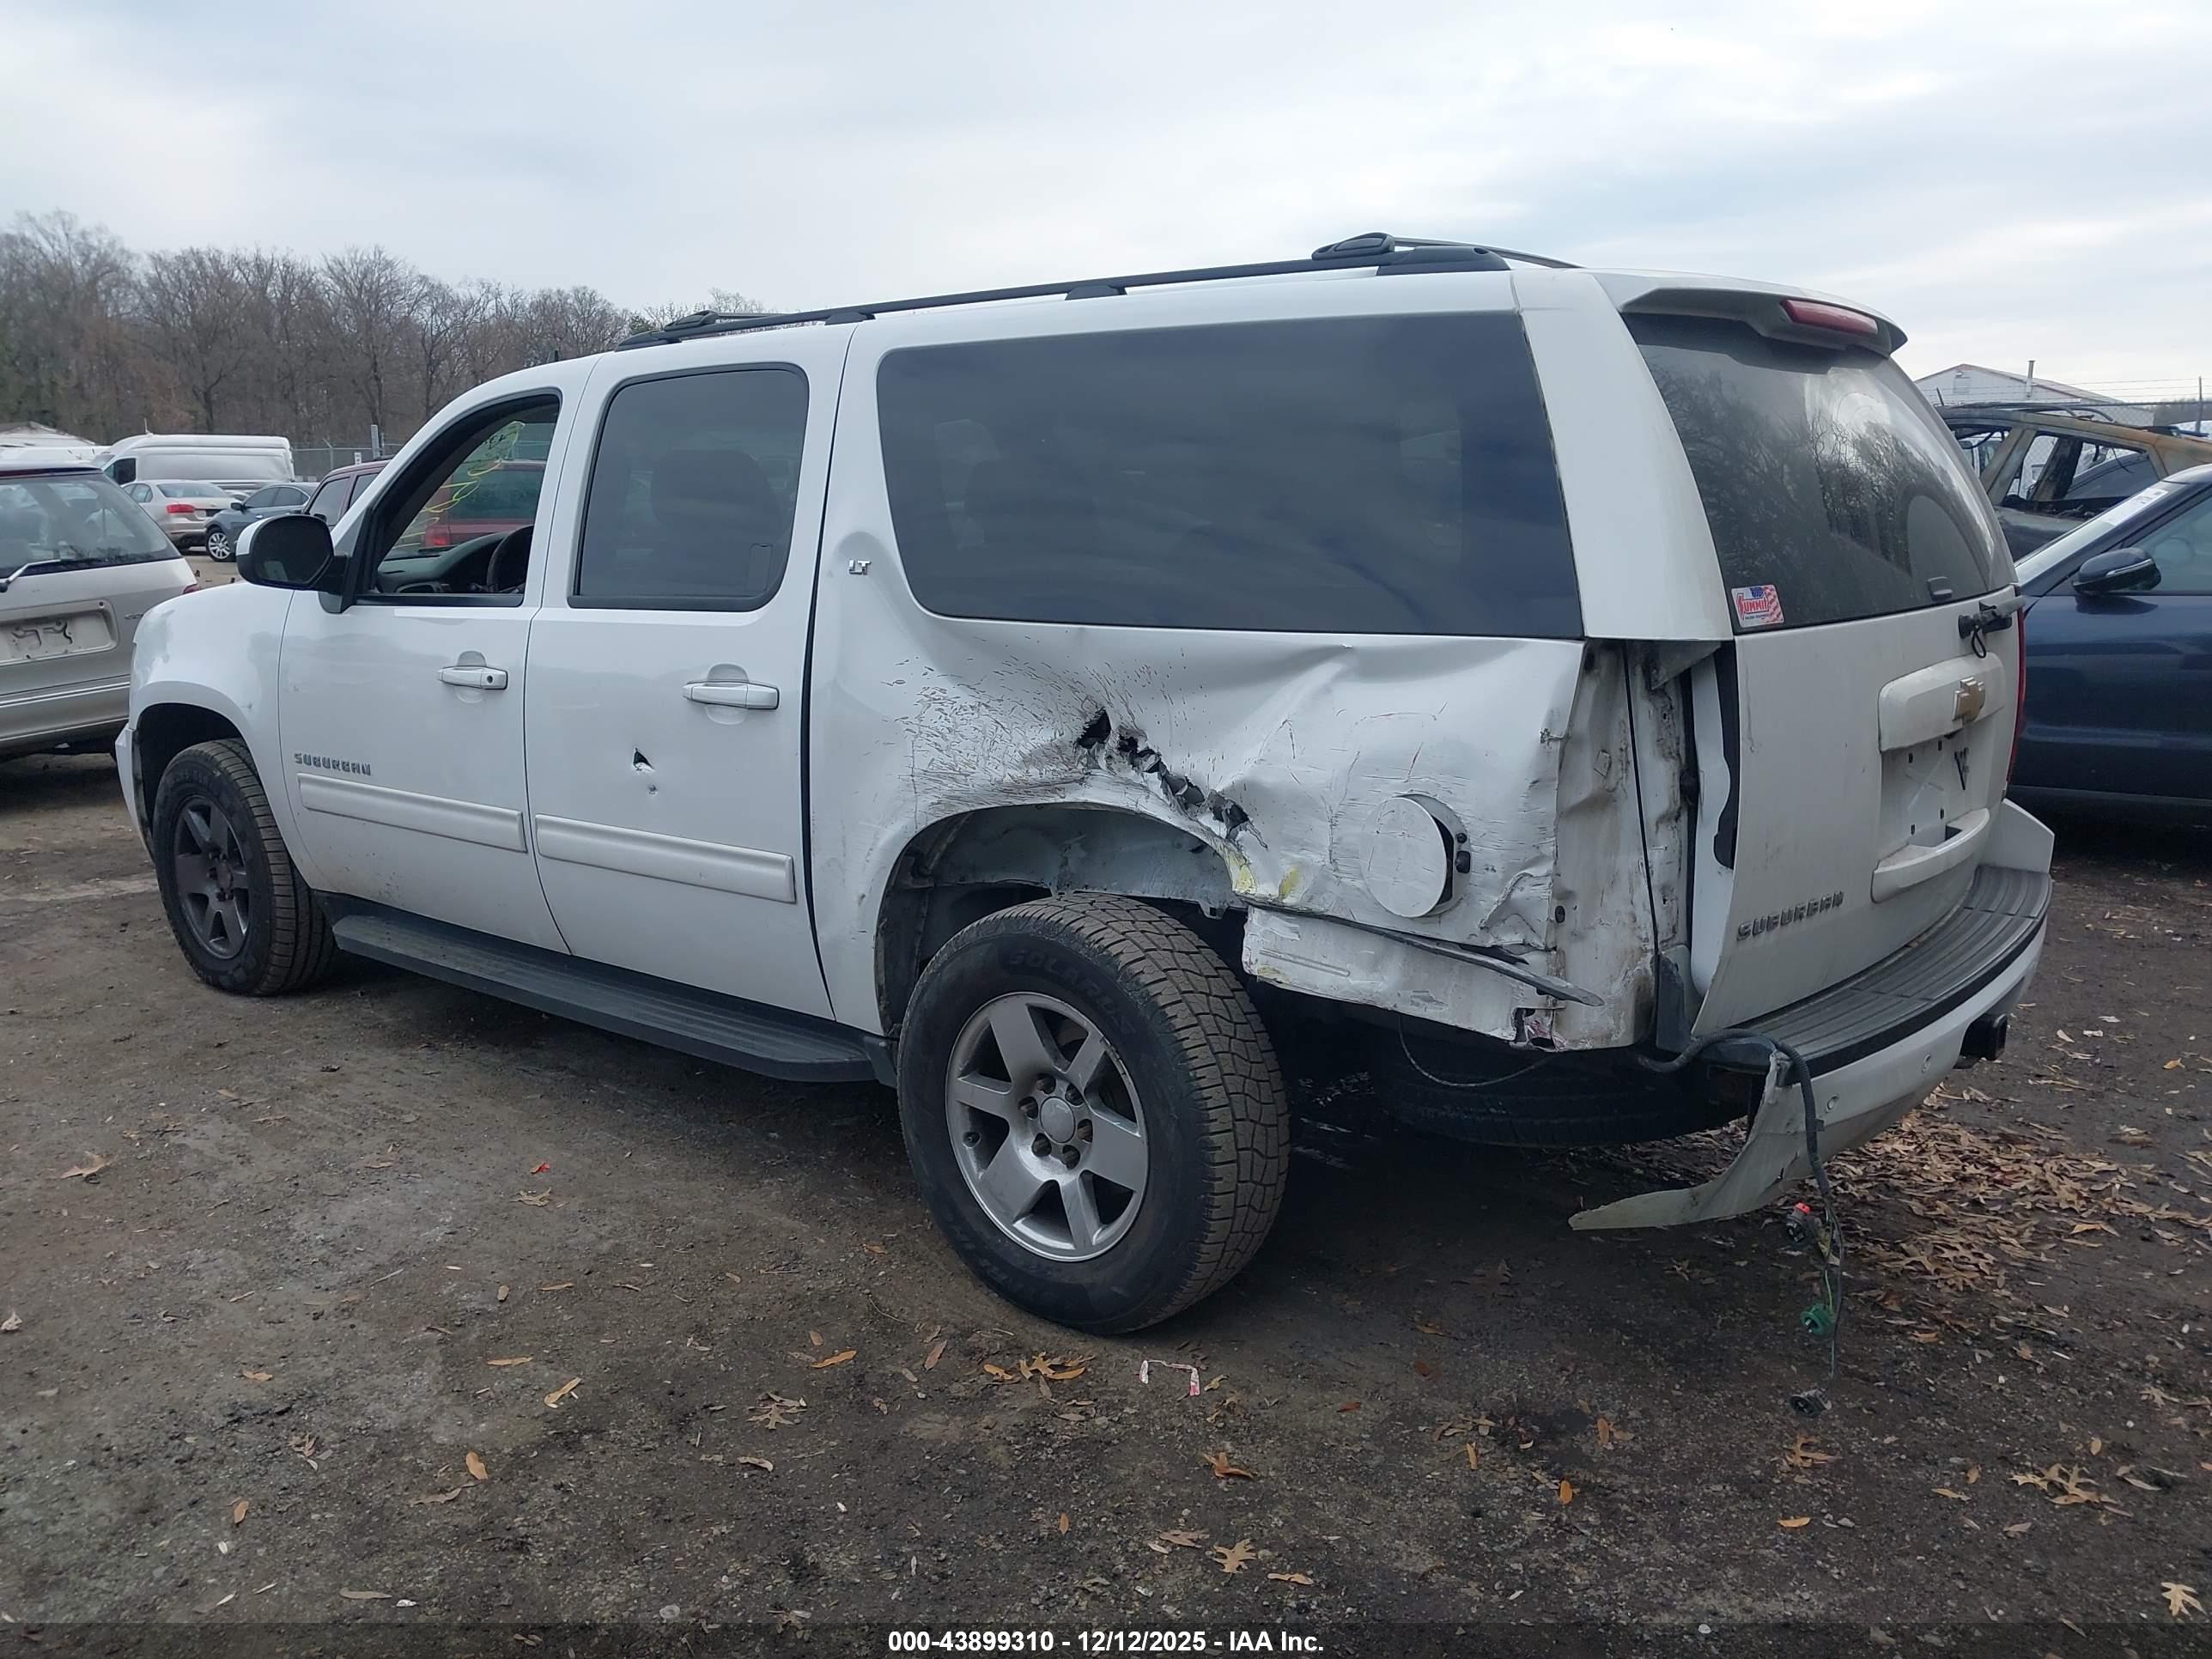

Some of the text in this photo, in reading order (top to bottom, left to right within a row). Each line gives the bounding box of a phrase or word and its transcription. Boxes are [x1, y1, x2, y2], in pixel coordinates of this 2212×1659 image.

[848, 559, 872, 575] LT
[1736, 592, 1770, 618] SUMMIT
[294, 752, 371, 776] SUBURBAN
[1736, 890, 1844, 942] SUBURBAN
